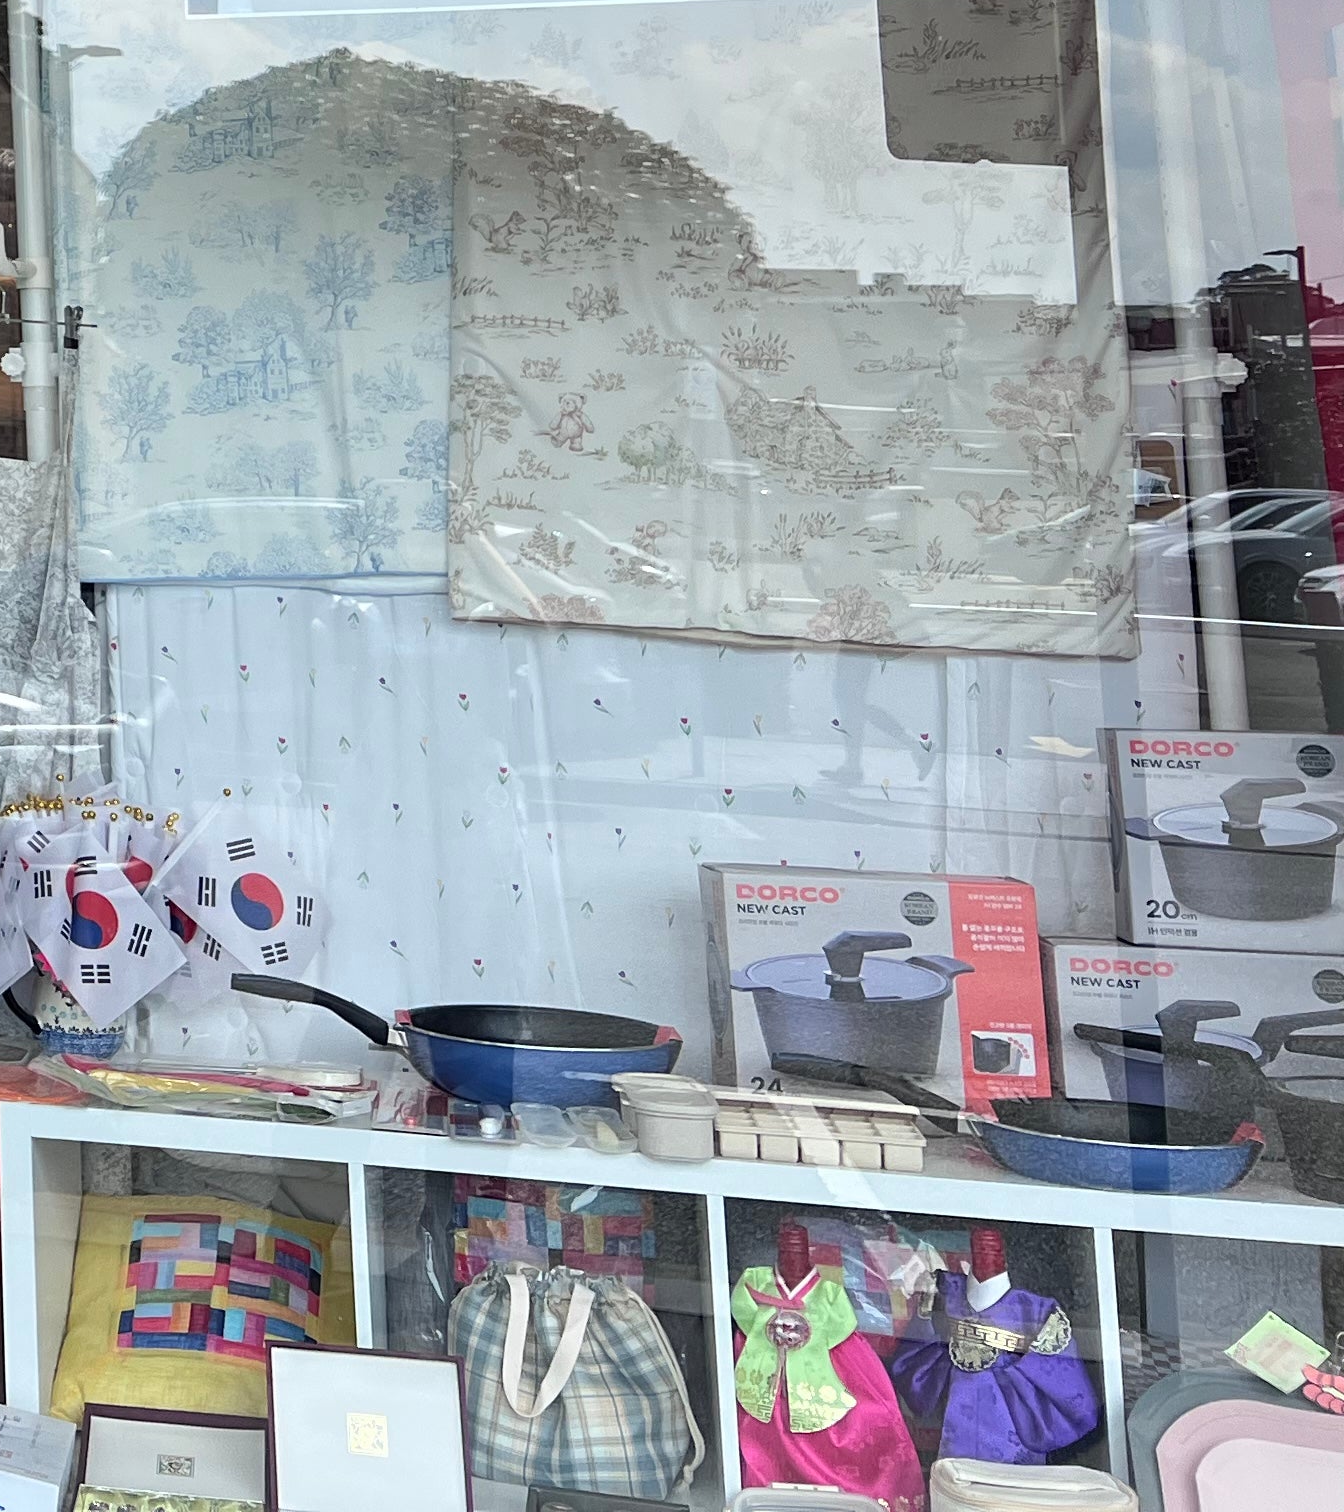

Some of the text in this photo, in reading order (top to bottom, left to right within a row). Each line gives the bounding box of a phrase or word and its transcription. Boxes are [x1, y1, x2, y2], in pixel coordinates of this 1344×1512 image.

[1128, 739, 1235, 758] DORCO
[1130, 758, 1201, 770] NEW CAST
[735, 883, 841, 904] DORCO
[736, 903, 807, 916] NEW CAST
[1068, 957, 1175, 978] DORCO
[1070, 976, 1141, 989] NEW CAST
